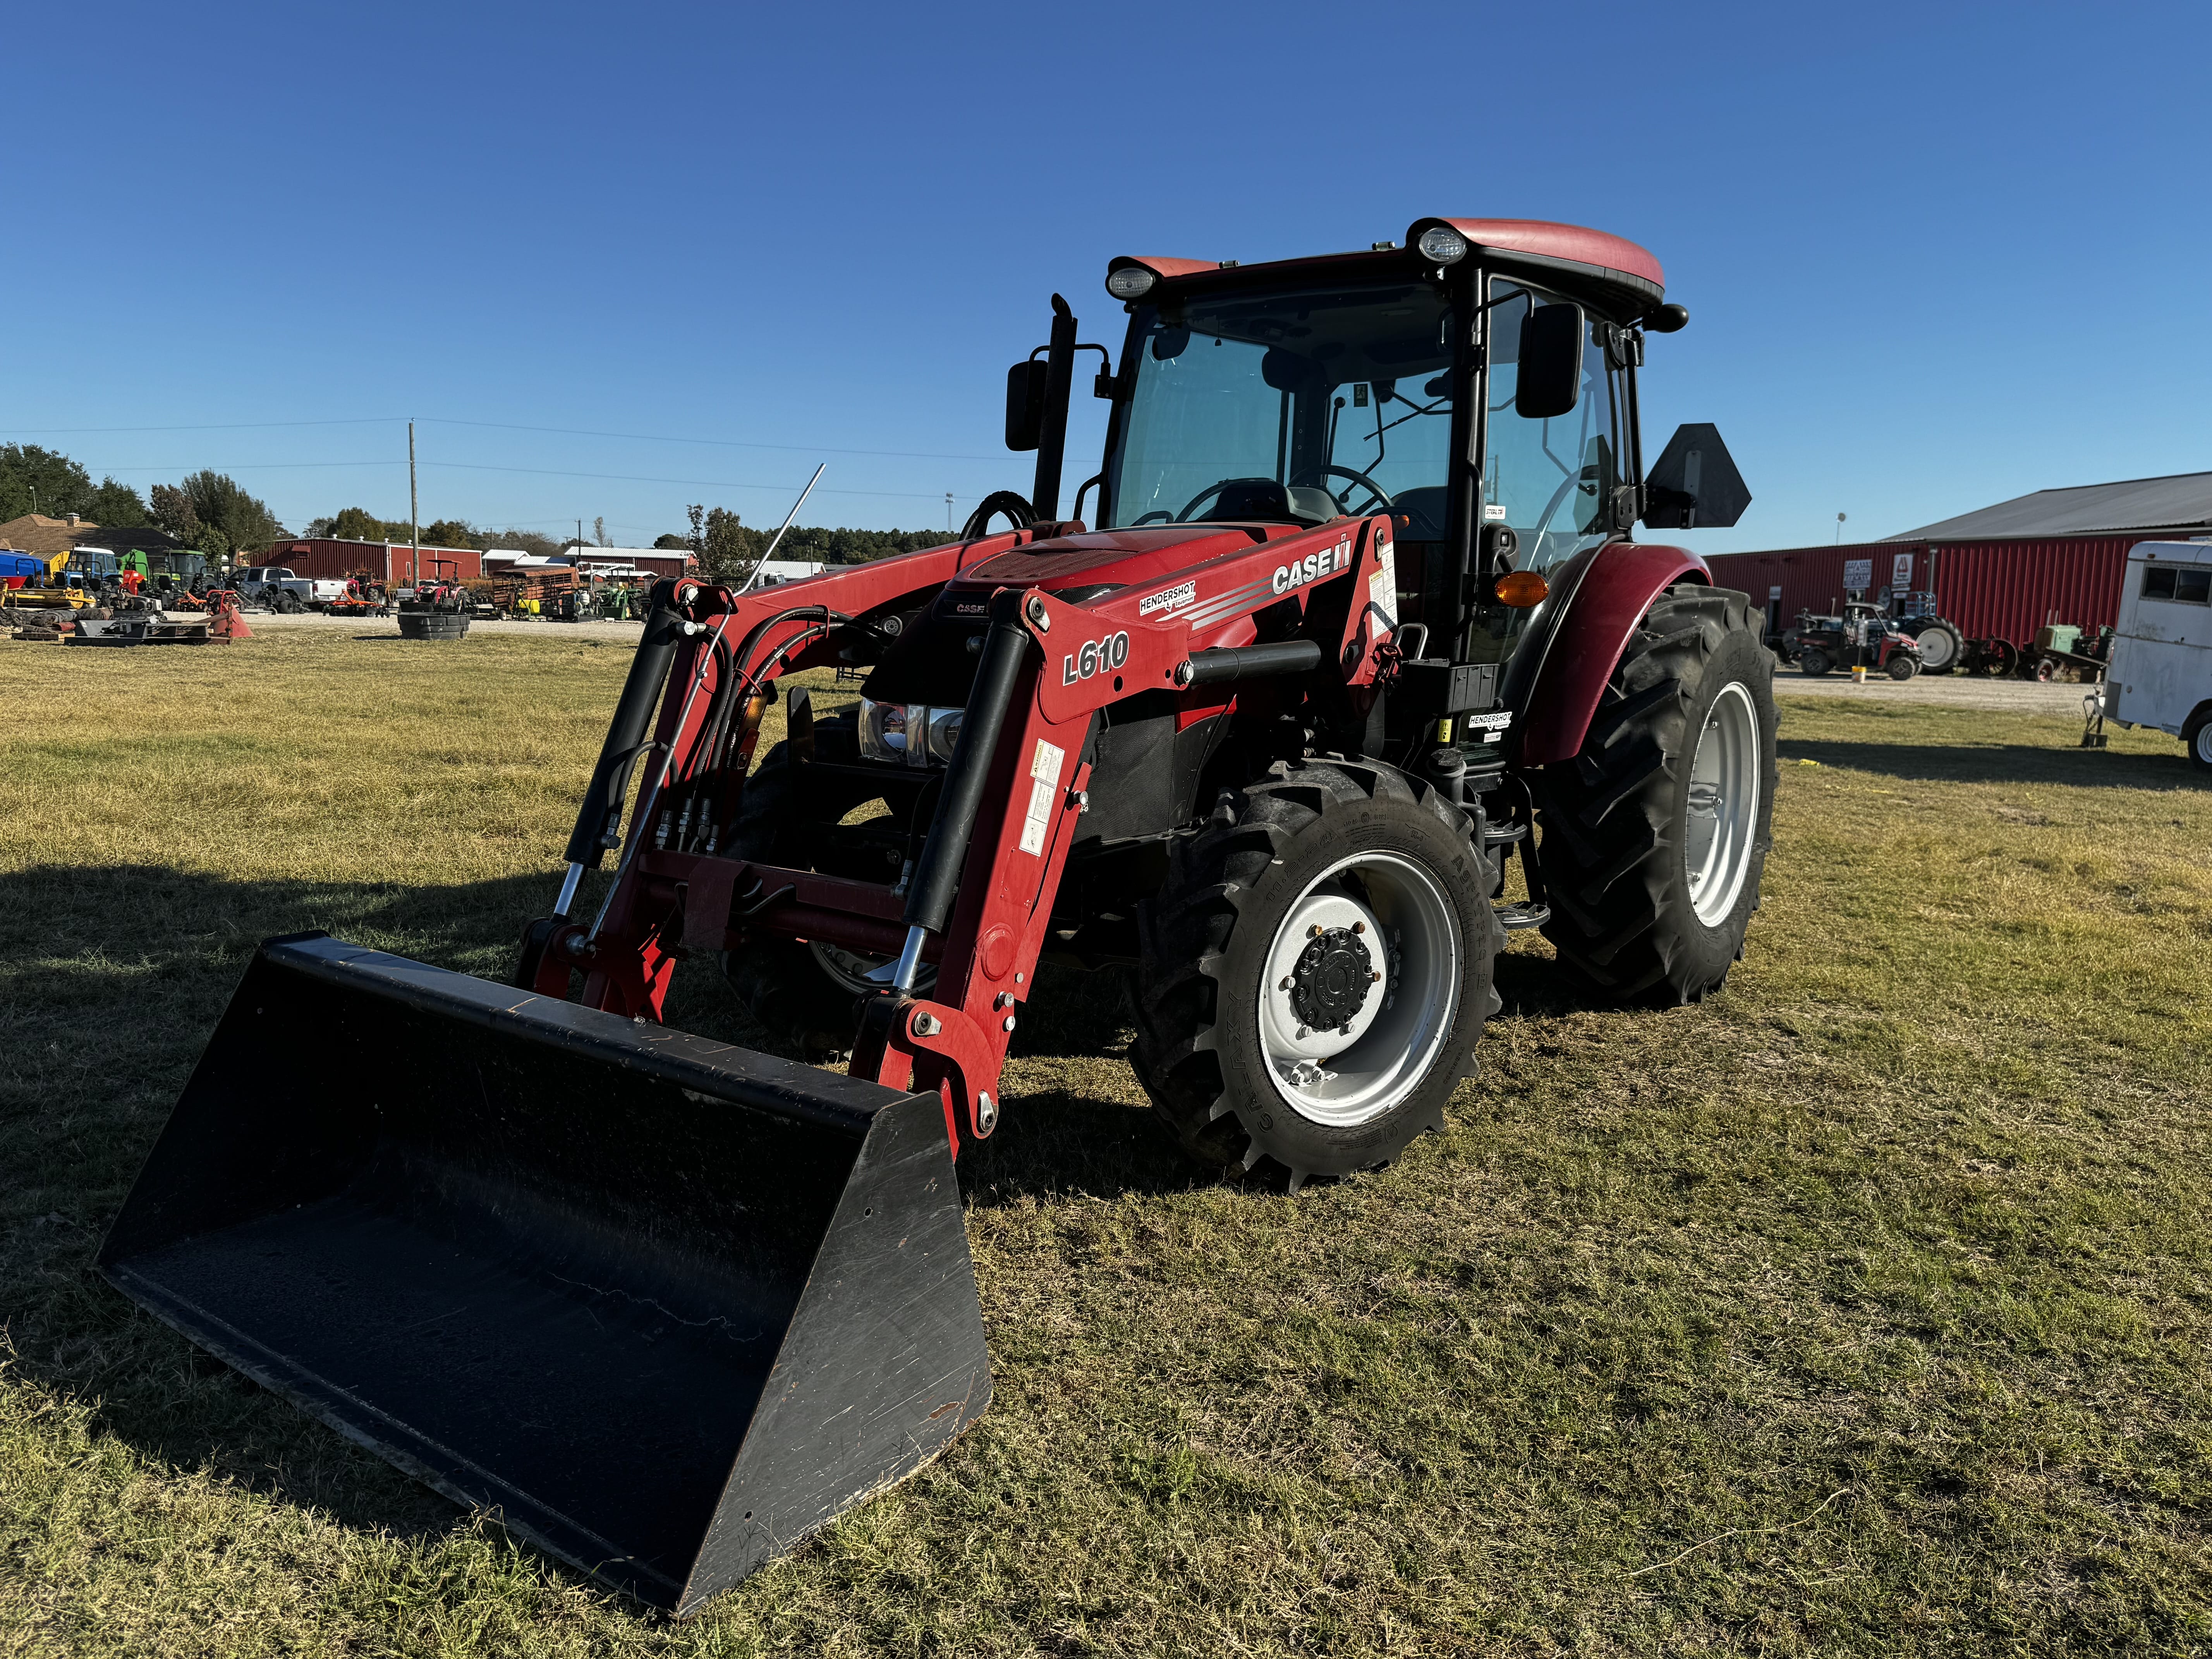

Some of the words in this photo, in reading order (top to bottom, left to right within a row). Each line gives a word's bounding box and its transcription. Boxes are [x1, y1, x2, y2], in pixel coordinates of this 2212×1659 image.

[1273, 548, 1331, 594] CASE
[957, 604, 985, 613] CASE
[1140, 582, 1194, 611] HENDERSHOT
[1063, 630, 1129, 686] L610
[1470, 713, 1511, 725] HENDERSHOT
[1266, 833, 1335, 902] 11.2-24
[1227, 990, 1274, 1133] GALAXY
